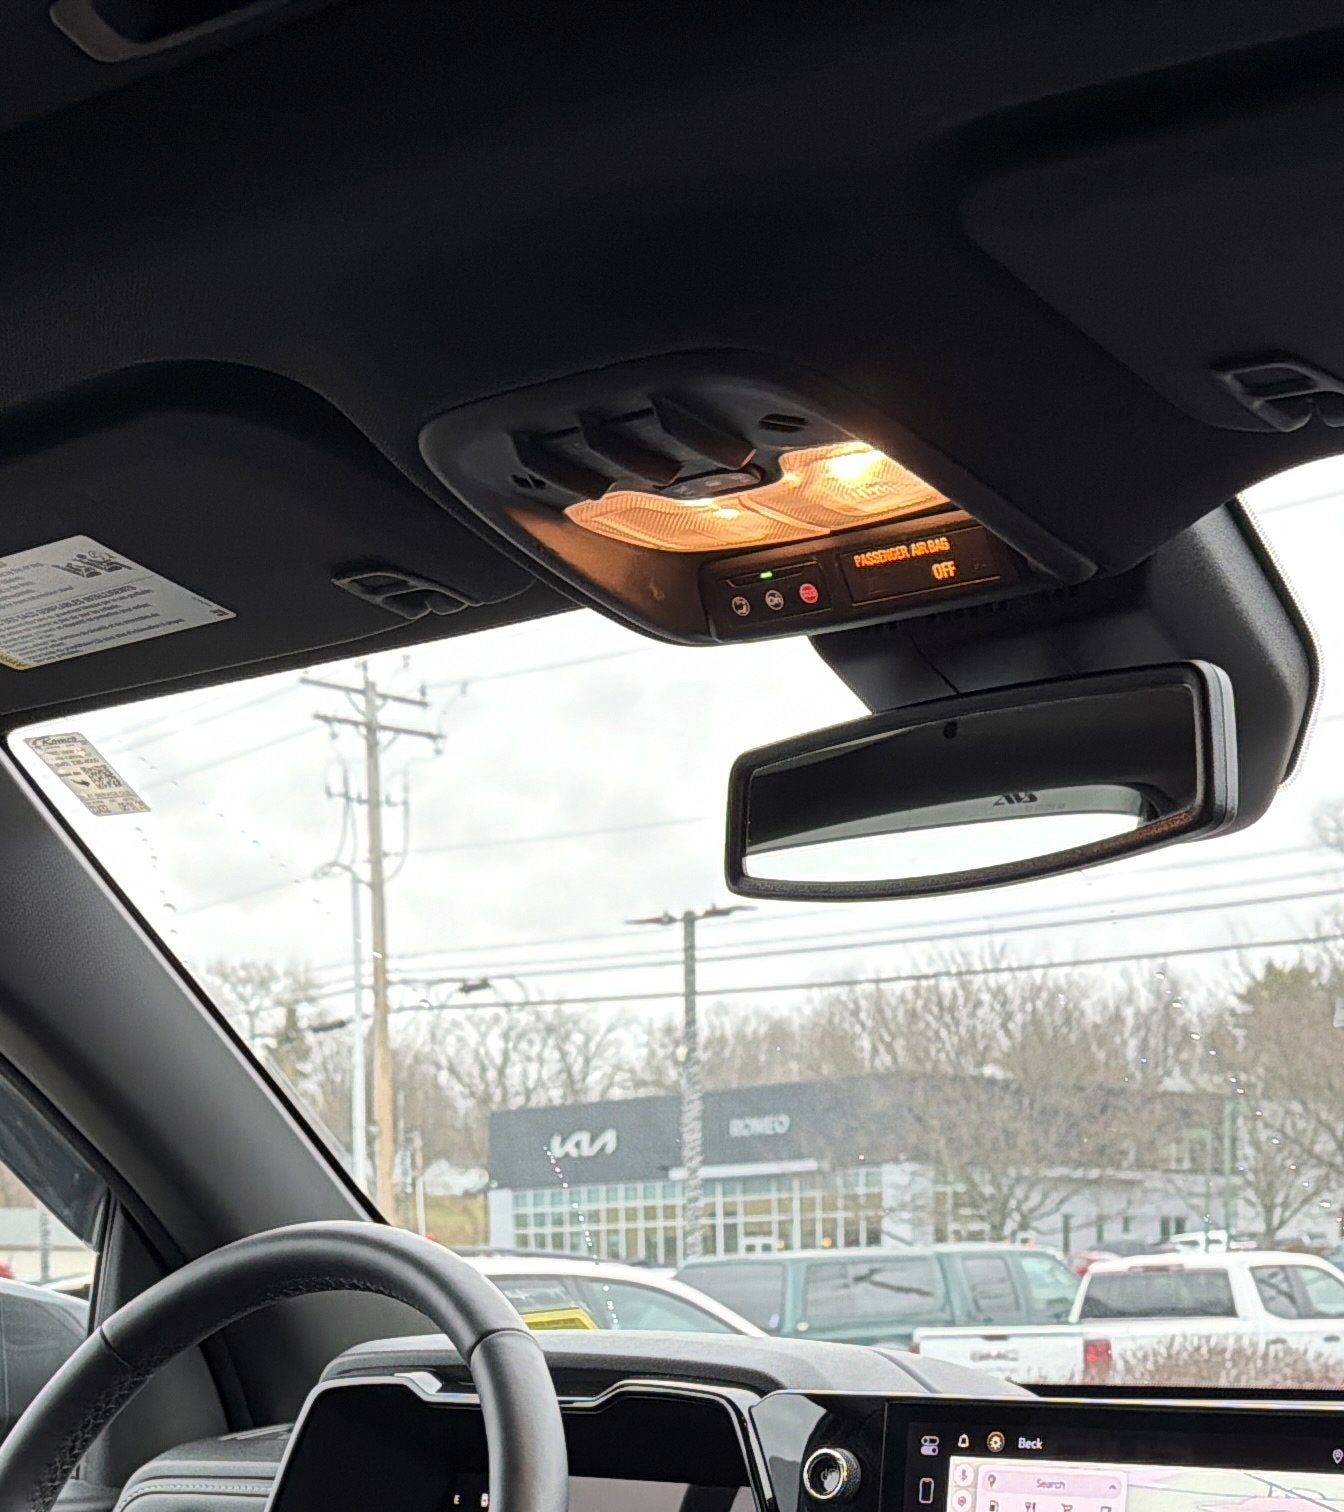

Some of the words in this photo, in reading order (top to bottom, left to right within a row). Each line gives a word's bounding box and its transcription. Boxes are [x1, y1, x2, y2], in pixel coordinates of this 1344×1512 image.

[853, 545, 910, 568] PASSENGER
[931, 560, 957, 580] OFF
[1018, 1437, 1044, 1450] Beck
[1036, 1479, 1066, 1490] Search
